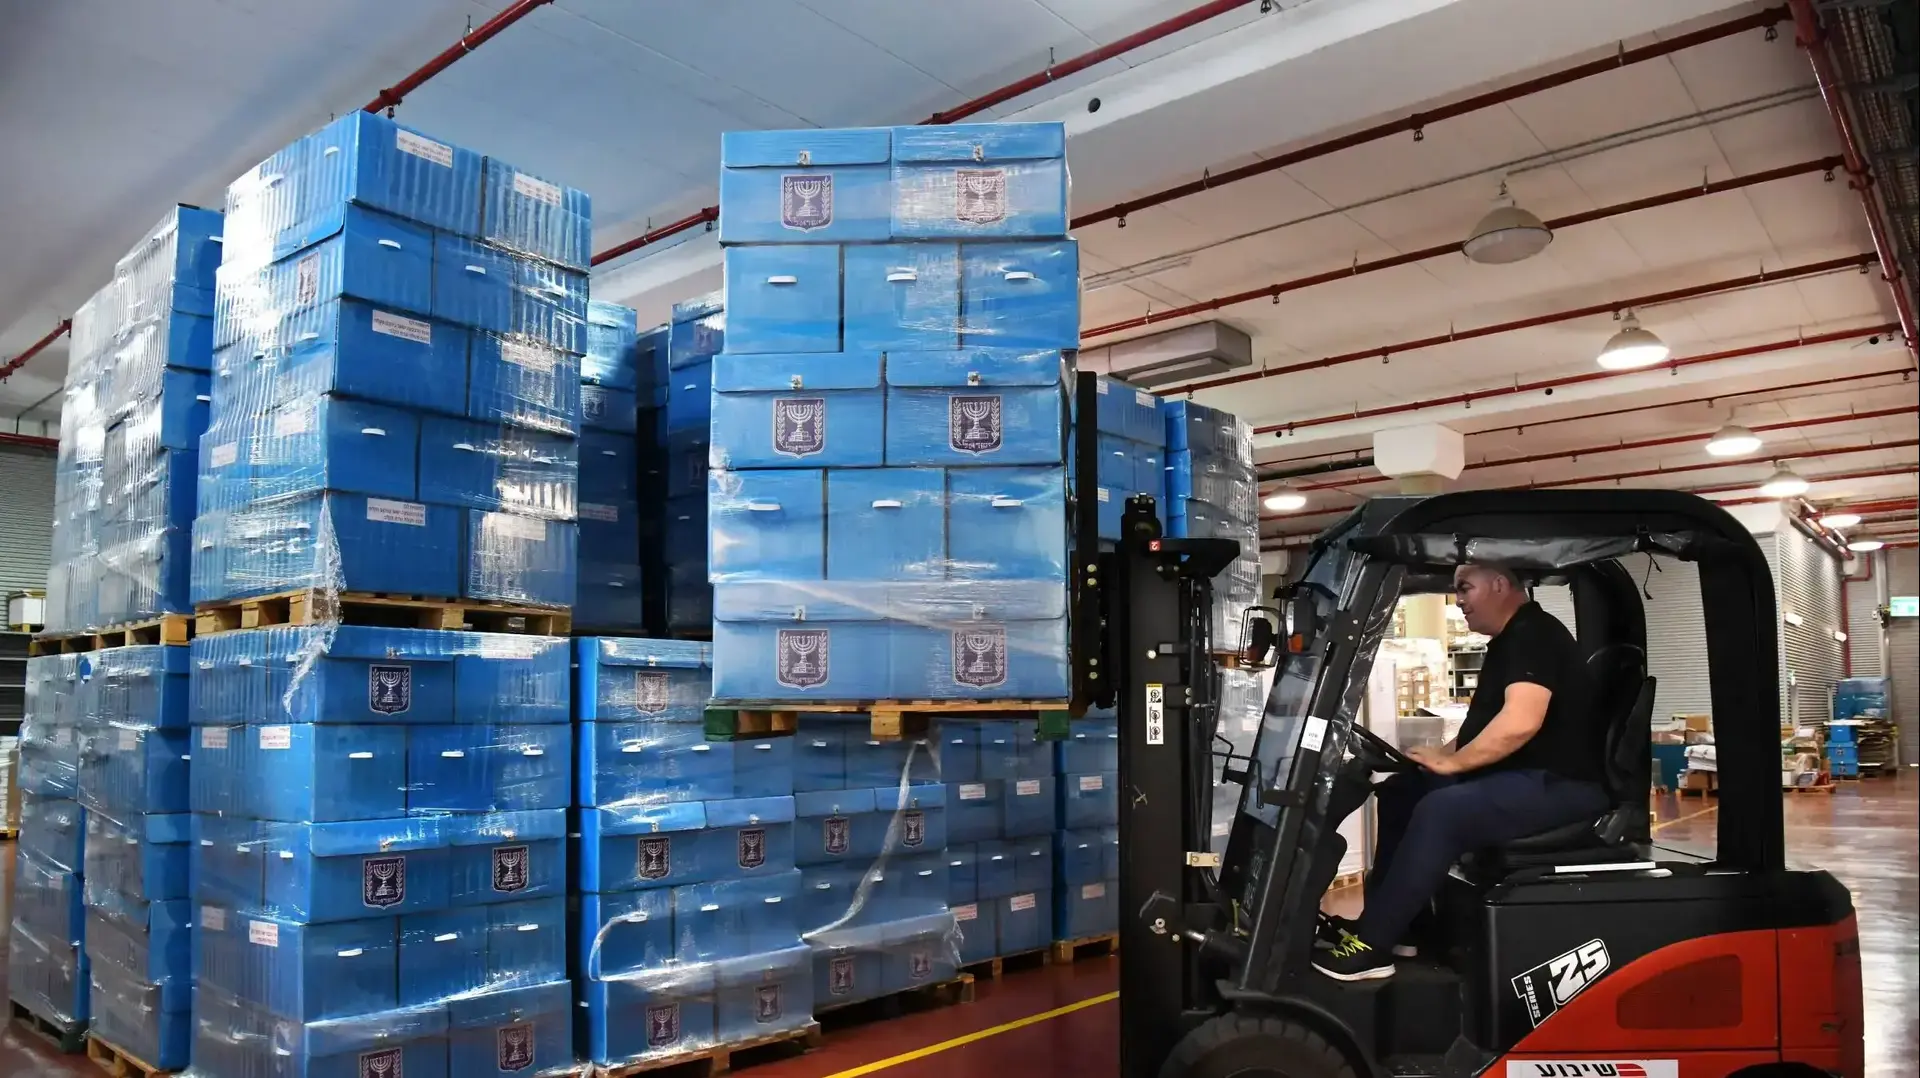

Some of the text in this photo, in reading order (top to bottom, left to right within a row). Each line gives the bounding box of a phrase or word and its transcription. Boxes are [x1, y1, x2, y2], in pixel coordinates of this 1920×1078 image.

[962, 439, 991, 449] ישראל
[1523, 975, 1541, 1018] SERIES
[1534, 1063, 1618, 1077] שינוע
